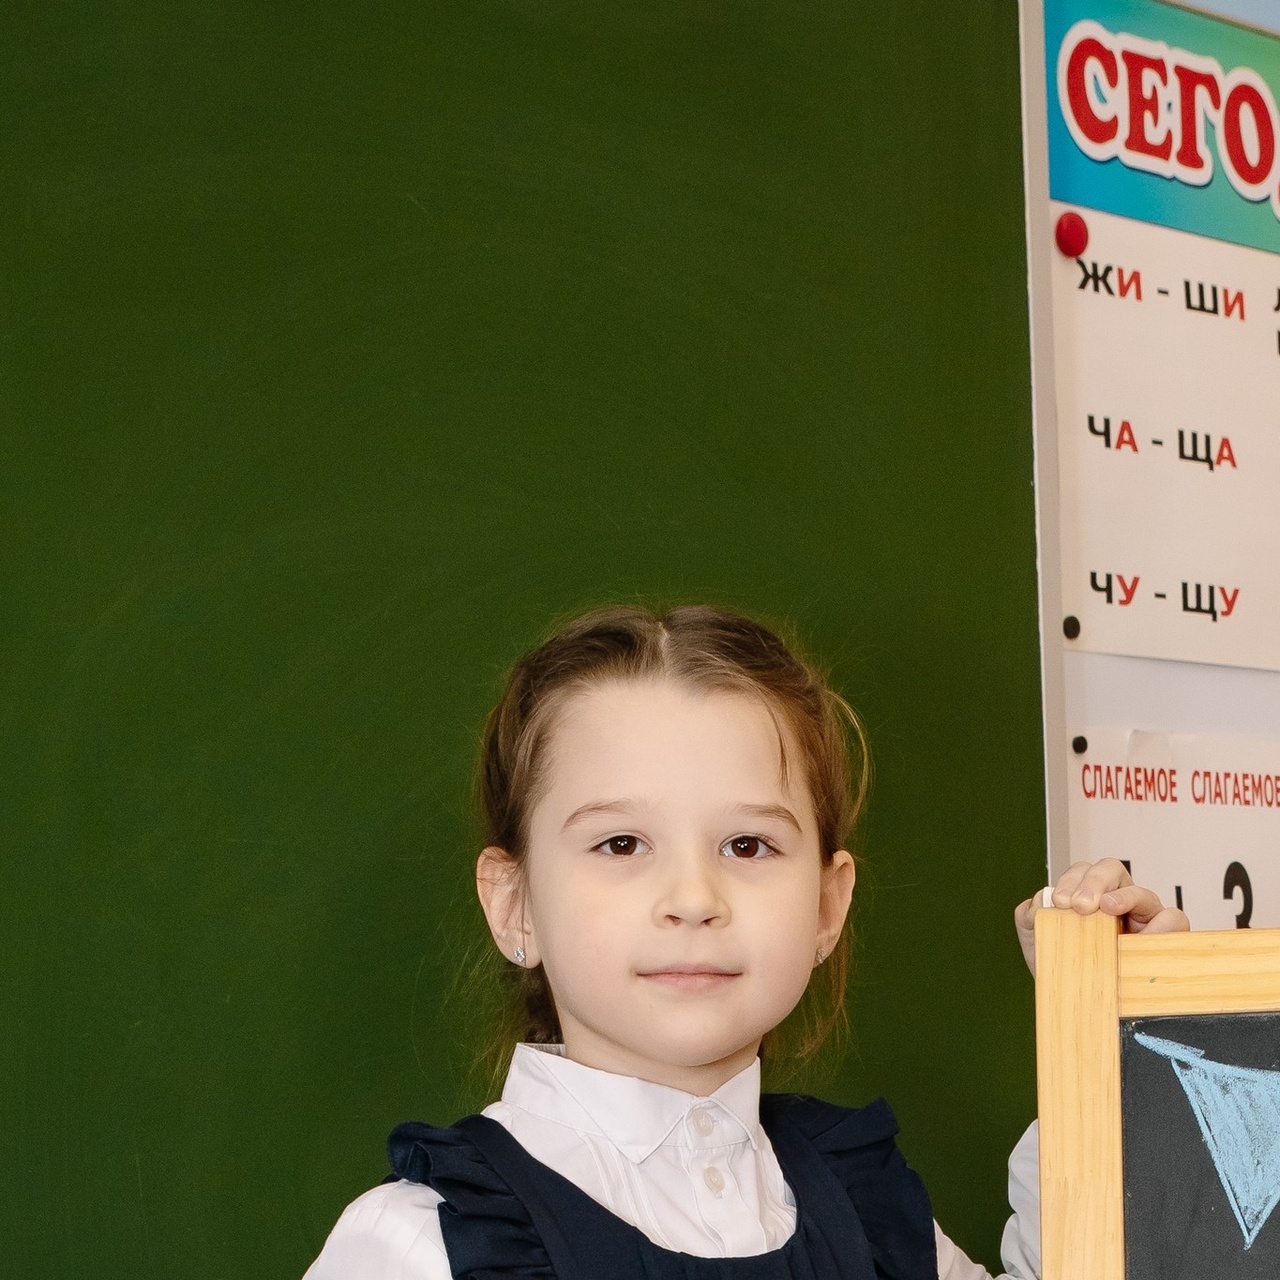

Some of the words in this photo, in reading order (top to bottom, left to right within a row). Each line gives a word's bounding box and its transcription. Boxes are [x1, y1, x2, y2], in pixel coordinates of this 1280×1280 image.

[1077, 260, 1143, 301] ЖИ
[1184, 280, 1246, 321] ШИ
[1087, 414, 1139, 454] ЧА
[1177, 429, 1238, 472] ЩА
[1090, 571, 1141, 606] ЧУ
[1181, 581, 1241, 623] ЩУ
[1081, 763, 1178, 803] СЛАГАЕМОЕ
